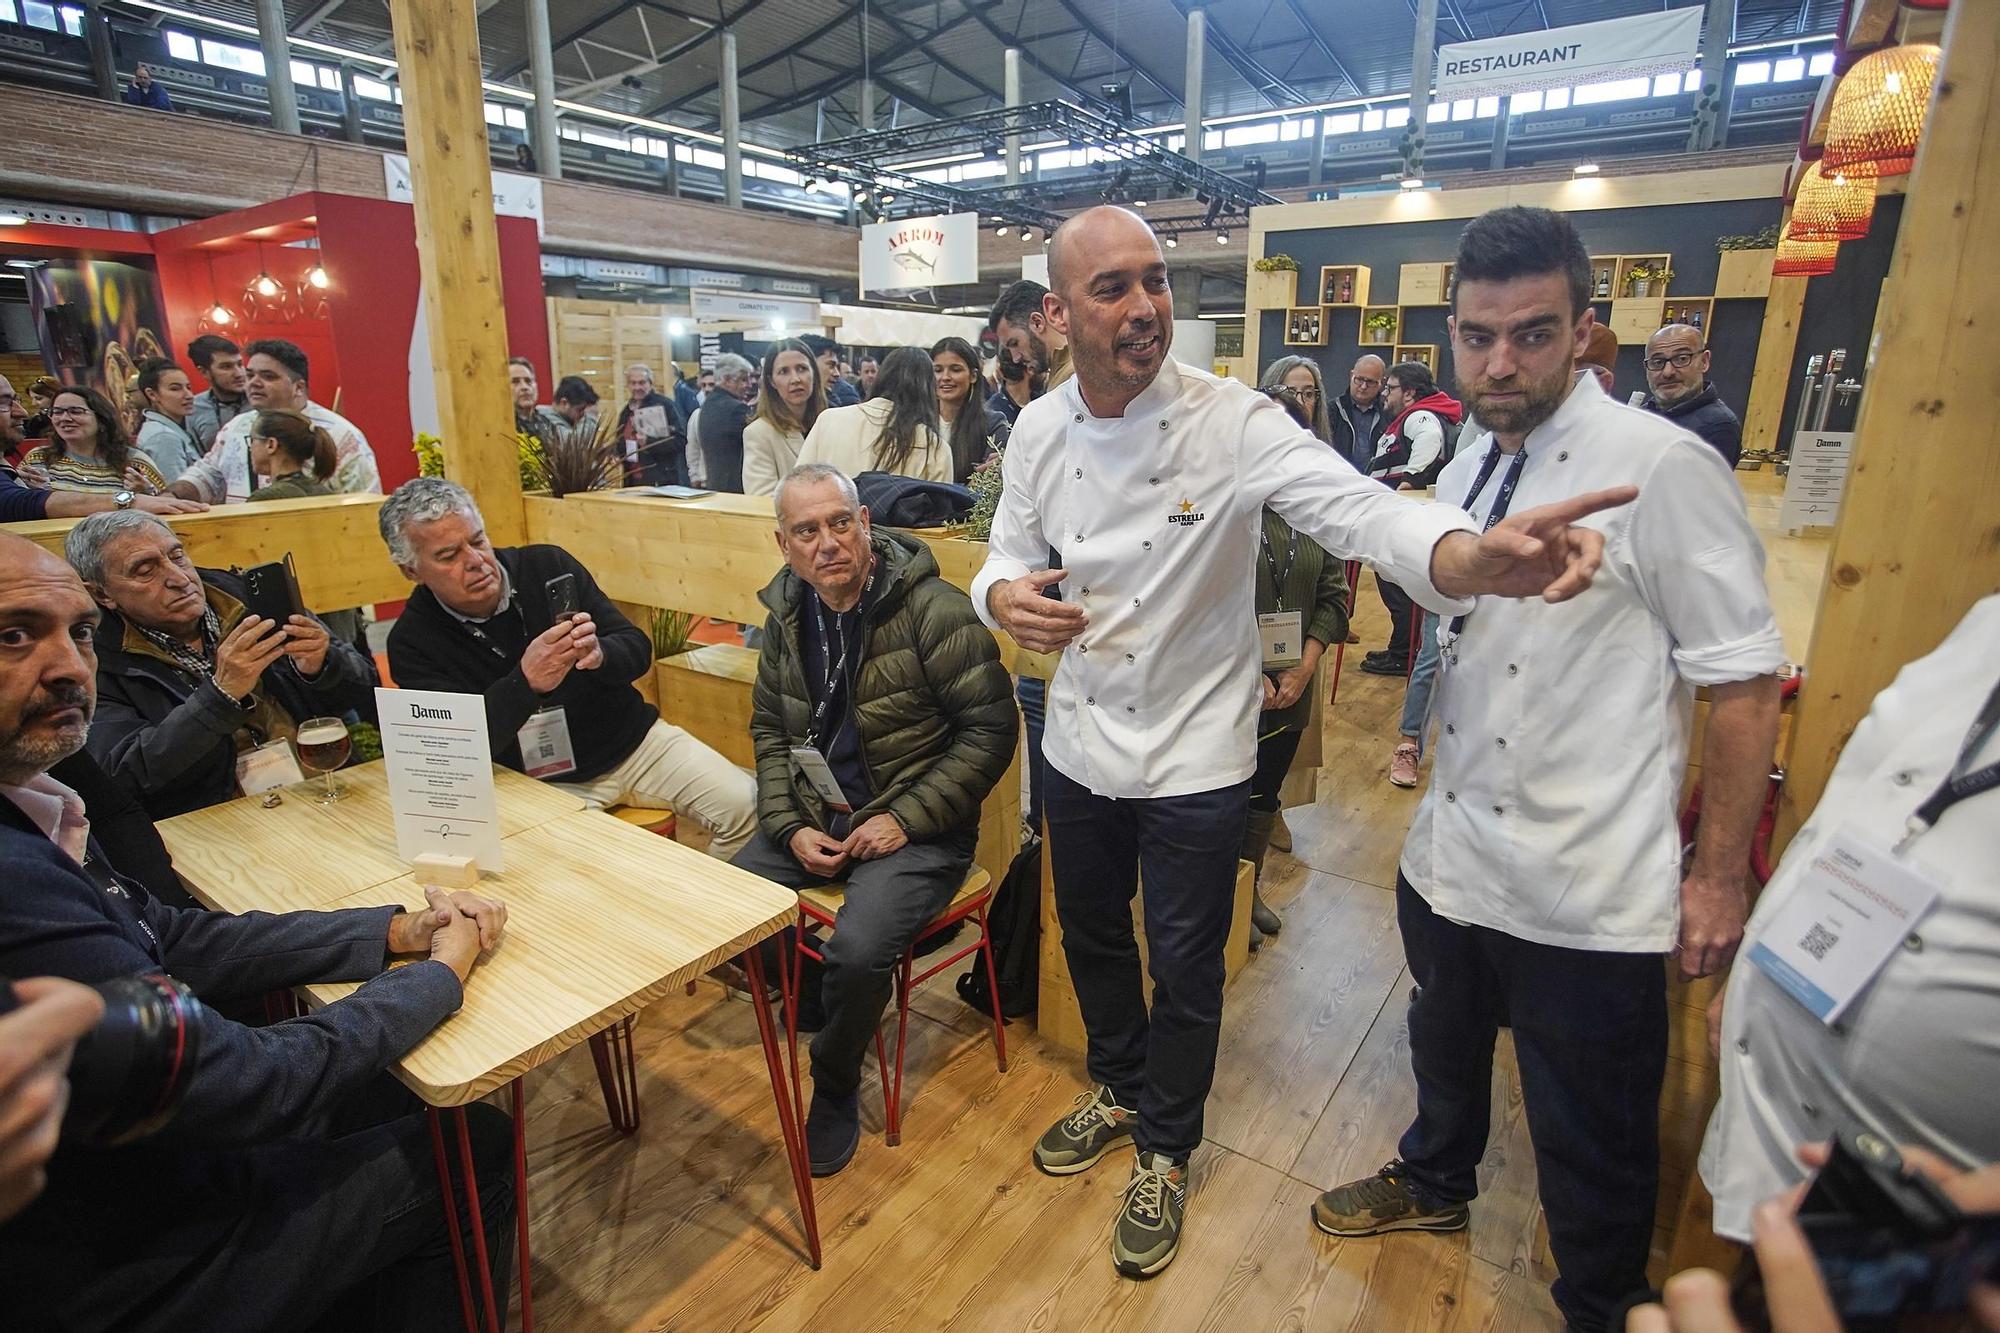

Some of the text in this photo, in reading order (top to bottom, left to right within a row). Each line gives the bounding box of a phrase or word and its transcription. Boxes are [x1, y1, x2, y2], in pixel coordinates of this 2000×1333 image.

[1445, 44, 1582, 76] RESTAURANT
[887, 228, 945, 252] ARROM
[1815, 439, 1842, 448] Damm
[1168, 512, 1205, 523] ESTRELLA
[409, 703, 453, 720] Damm
